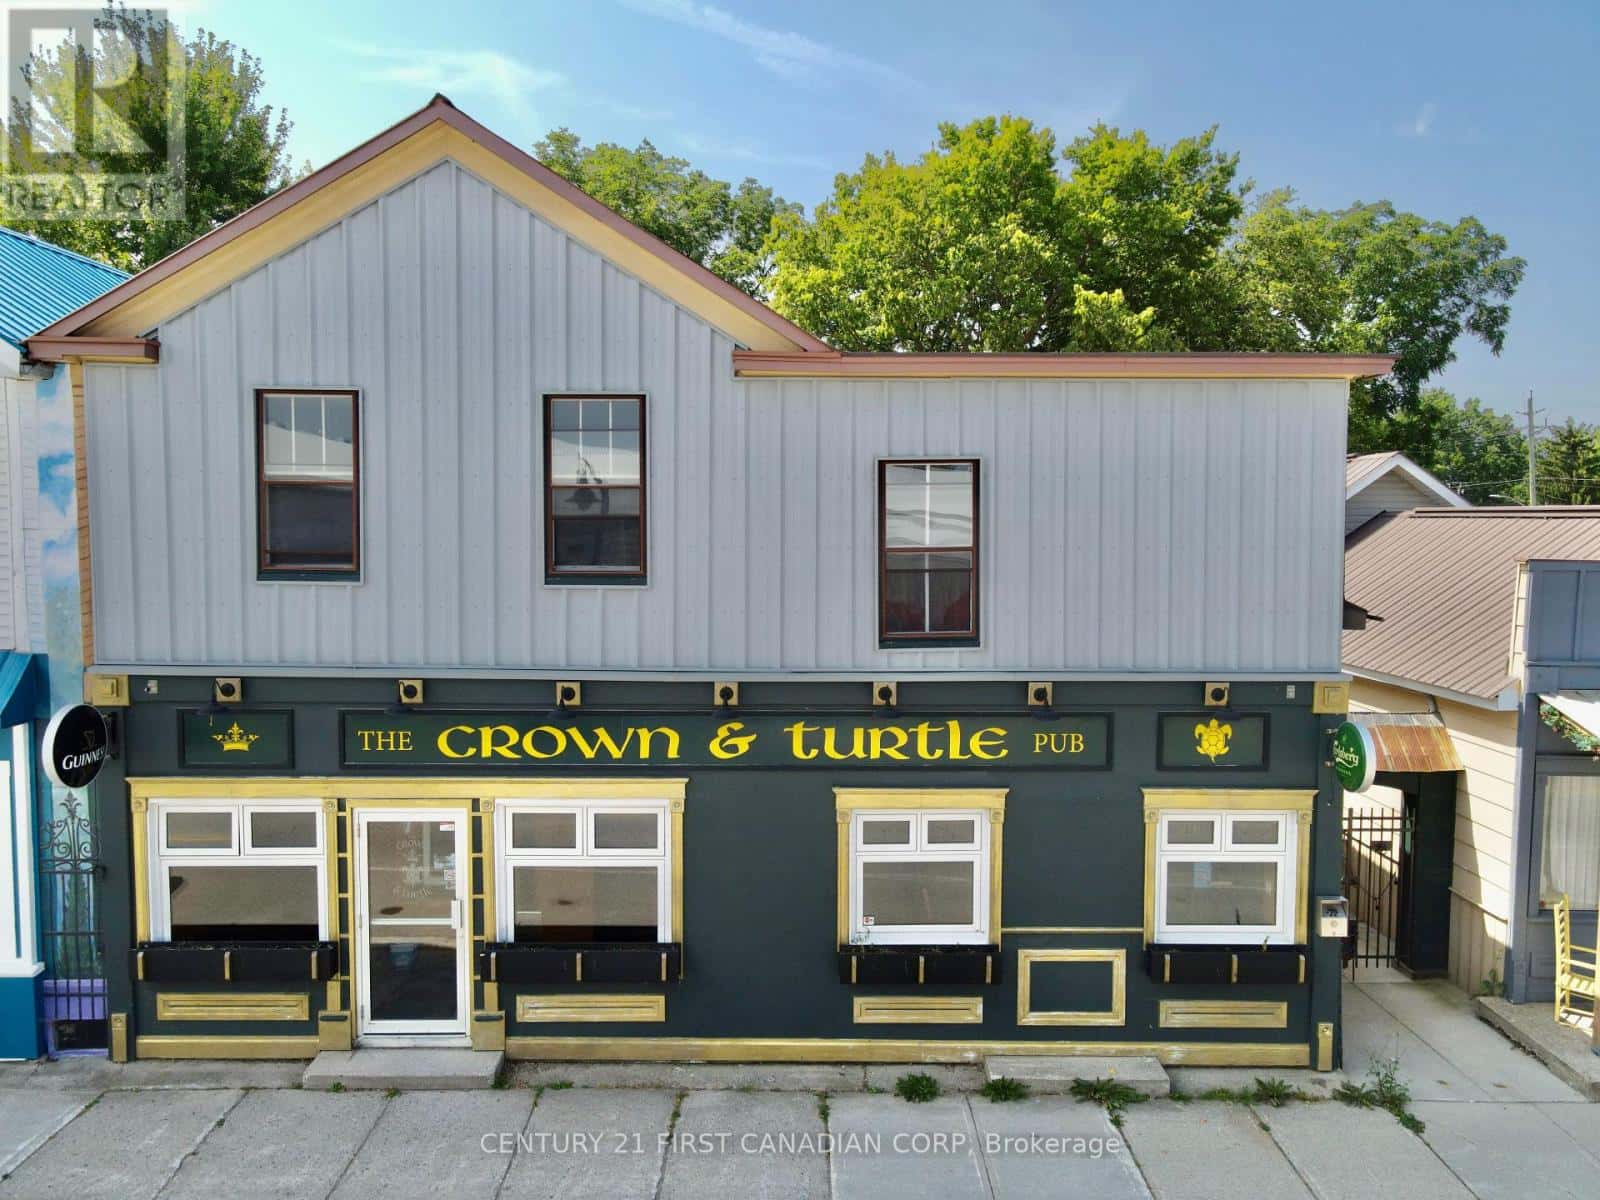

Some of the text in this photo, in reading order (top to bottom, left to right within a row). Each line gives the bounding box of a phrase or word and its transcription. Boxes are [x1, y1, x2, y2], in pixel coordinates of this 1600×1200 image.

[357, 730, 413, 751] THE
[437, 725, 680, 759] CROWN
[708, 721, 757, 760] &
[1033, 732, 1085, 753] PUB
